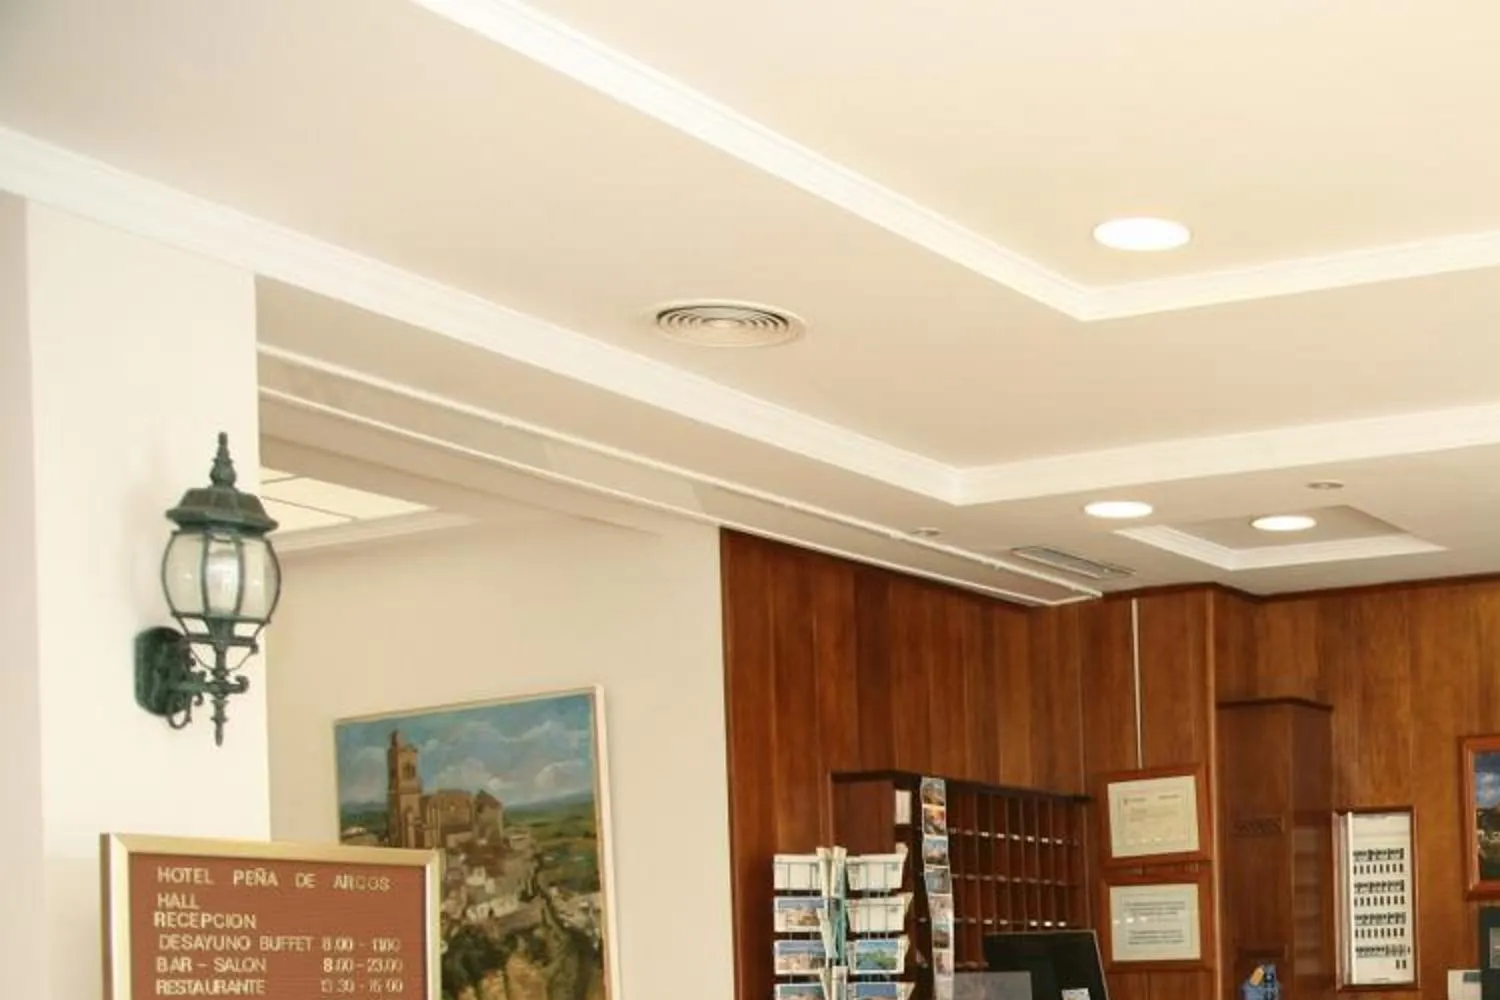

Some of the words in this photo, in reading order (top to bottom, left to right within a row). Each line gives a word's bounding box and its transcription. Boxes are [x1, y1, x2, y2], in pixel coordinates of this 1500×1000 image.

[157, 866, 214, 885] HOTEL
[232, 867, 278, 887] PEÑA
[295, 872, 317, 888] DE
[333, 873, 391, 892] ARCOS
[157, 892, 200, 910] HALL
[154, 911, 257, 929] RECEPCION
[158, 933, 251, 952] DESAYUNO
[259, 935, 312, 952] BUFFET
[156, 957, 193, 973] BAR
[213, 957, 267, 973] SALON
[155, 978, 266, 996] RESTAURANTE
